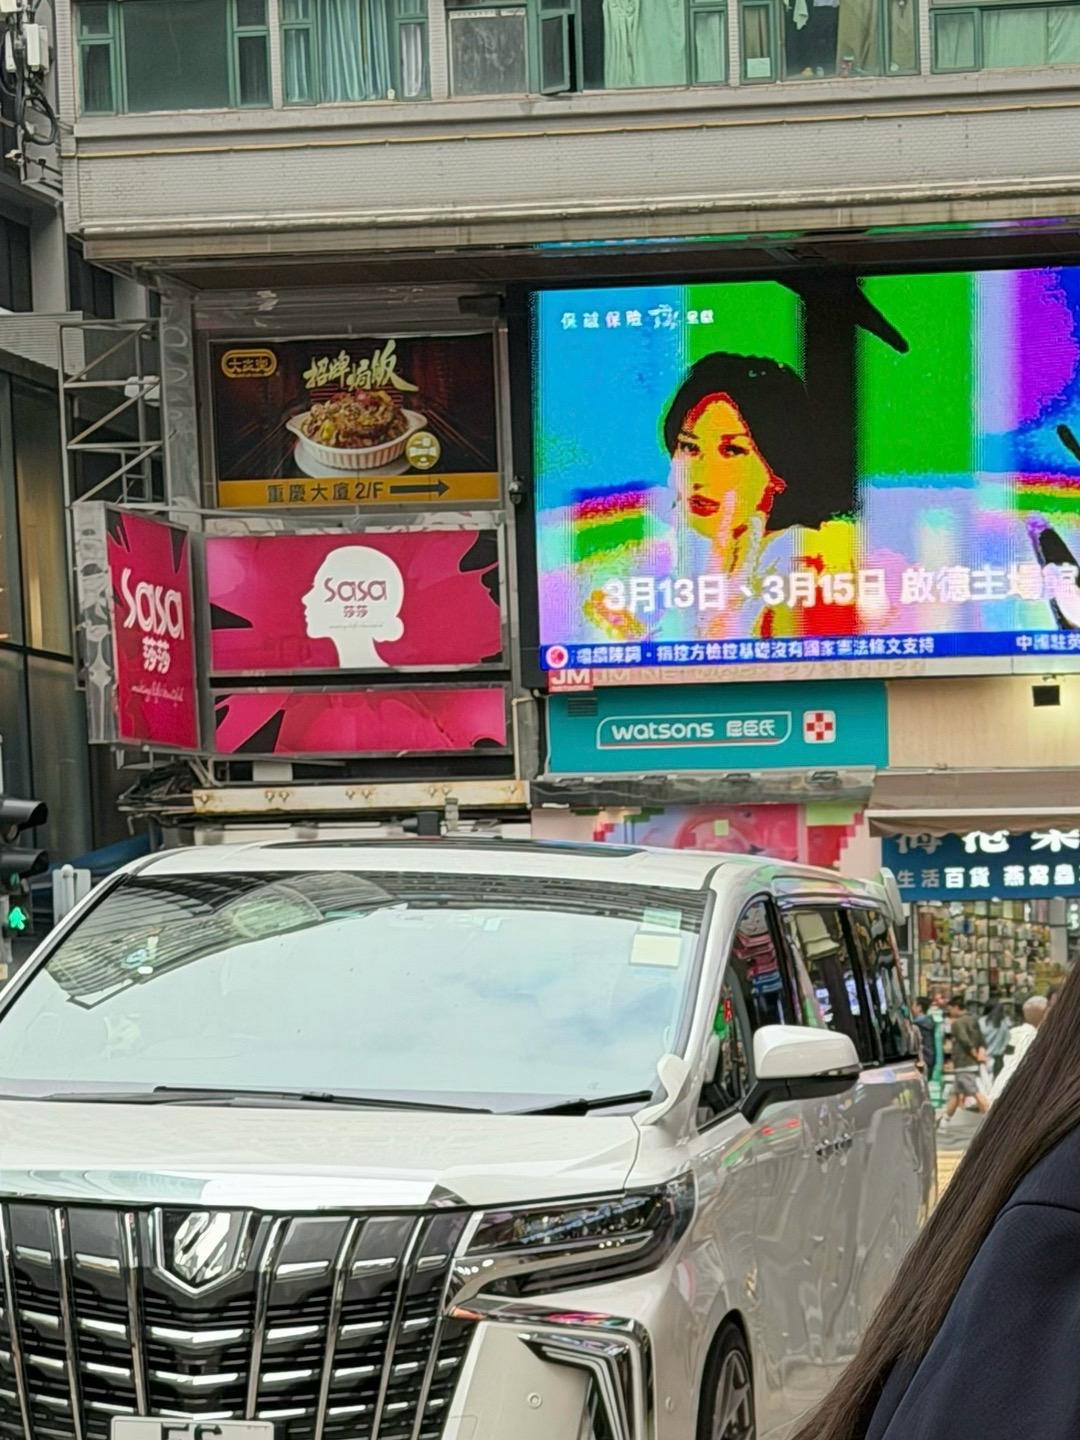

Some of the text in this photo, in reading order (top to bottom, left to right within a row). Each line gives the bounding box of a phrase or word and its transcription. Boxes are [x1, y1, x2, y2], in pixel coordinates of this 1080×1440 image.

[267, 482, 384, 504] 重慶大廈 2/F
[551, 669, 591, 685] JM
[611, 722, 714, 741] watsons
[897, 866, 990, 889] 生活百貨
